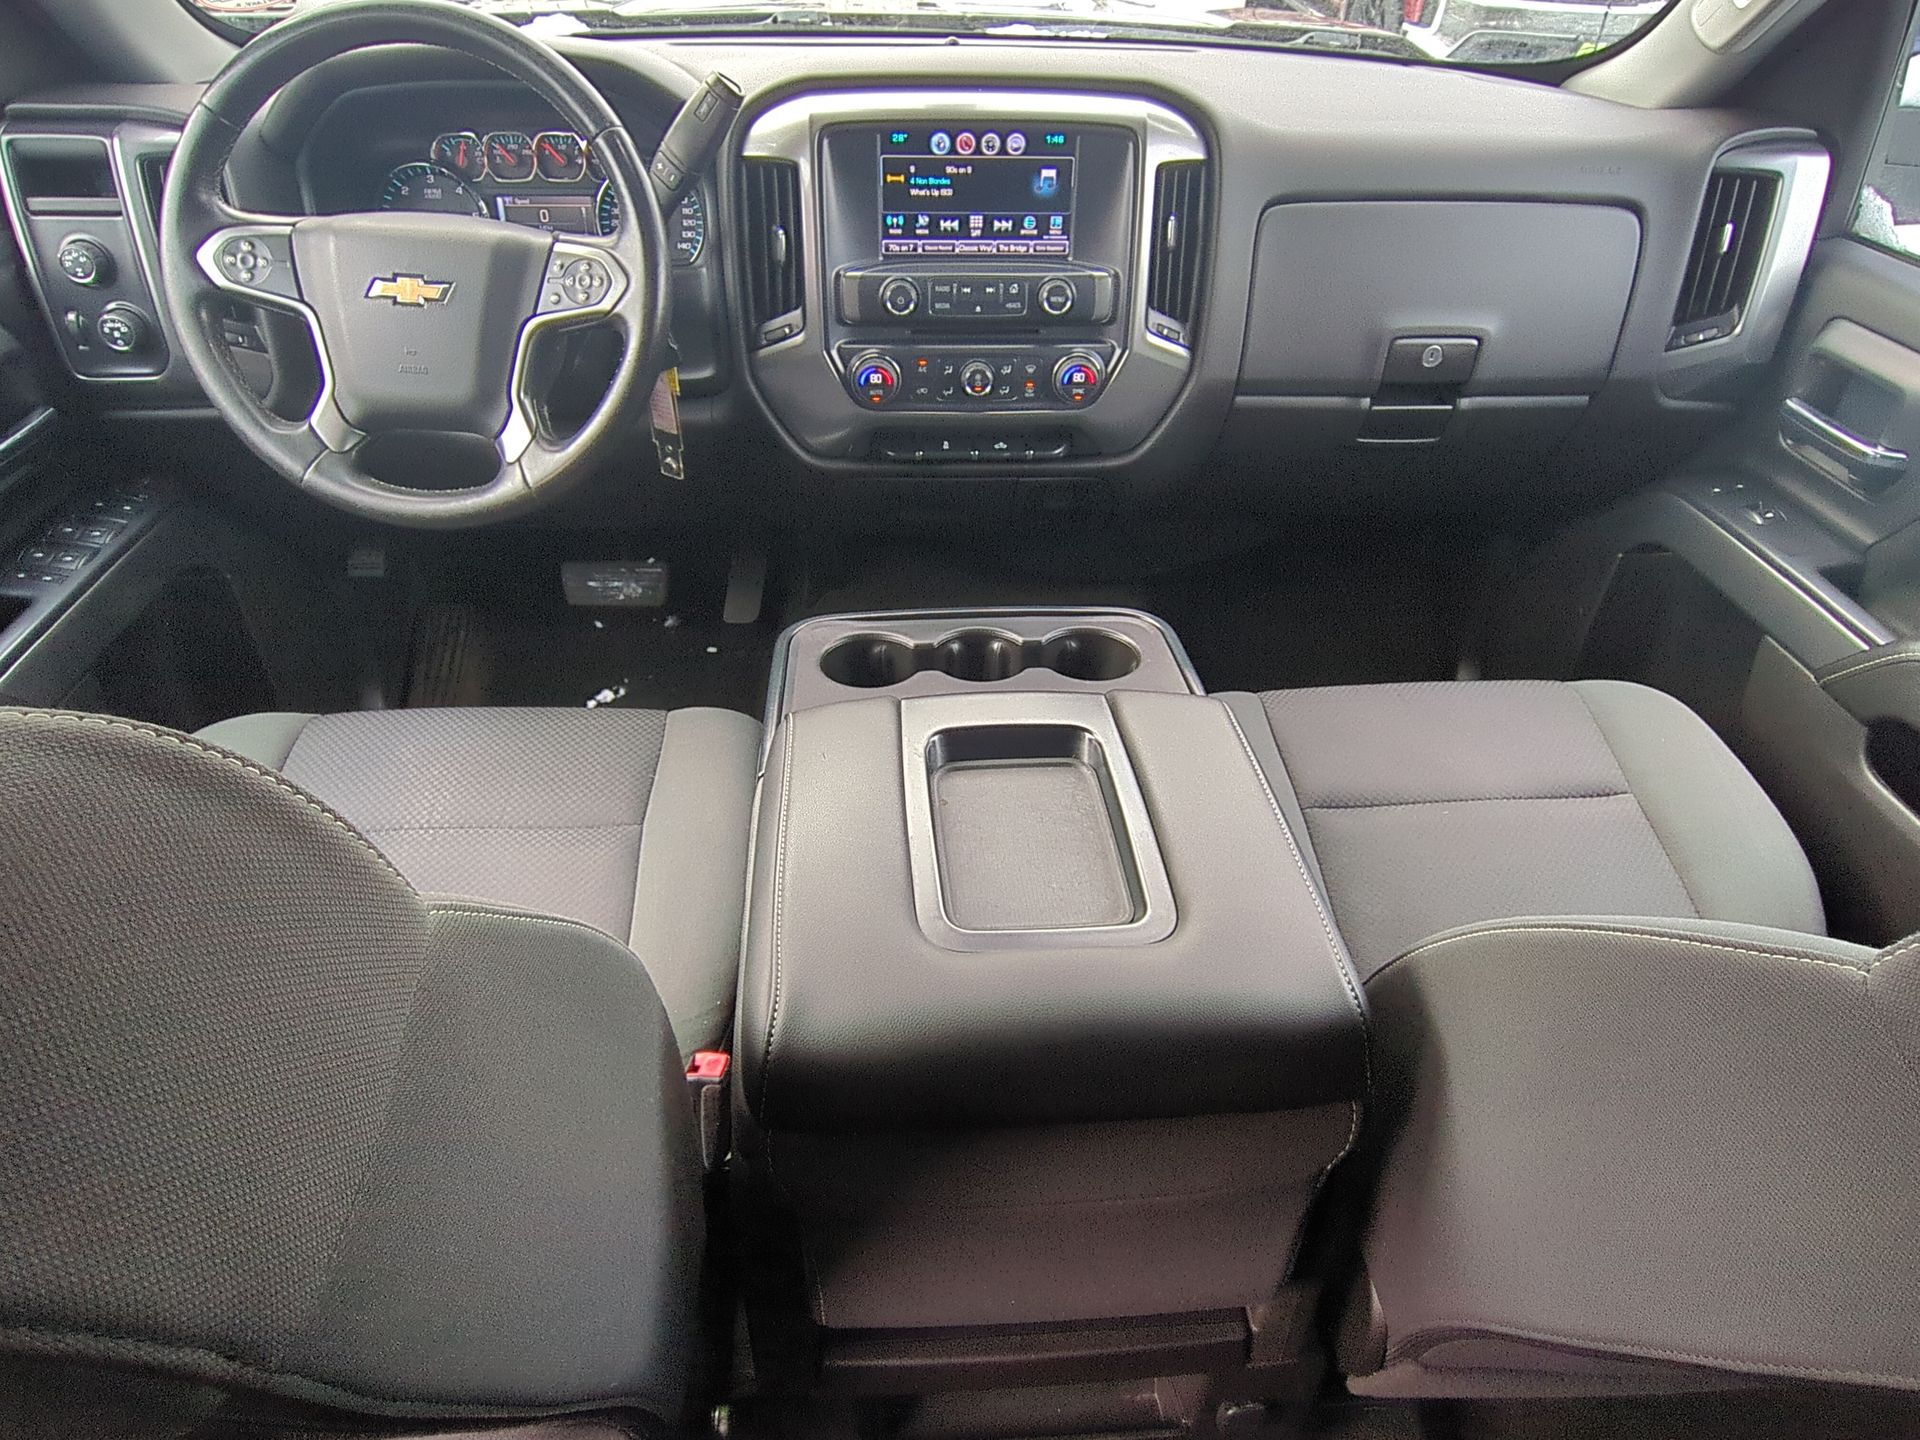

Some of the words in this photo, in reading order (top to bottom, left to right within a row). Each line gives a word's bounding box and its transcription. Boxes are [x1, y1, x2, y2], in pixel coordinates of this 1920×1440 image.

[426, 174, 435, 184] 3
[916, 177, 928, 185] Non
[928, 177, 951, 185] Blondes
[401, 186, 409, 196] 2
[455, 186, 463, 195] 4
[910, 188, 930, 196] What's
[931, 188, 940, 197] Up
[540, 209, 549, 223] 0
[682, 230, 696, 238] 130
[870, 373, 882, 384] 80
[1072, 372, 1086, 383] 80
